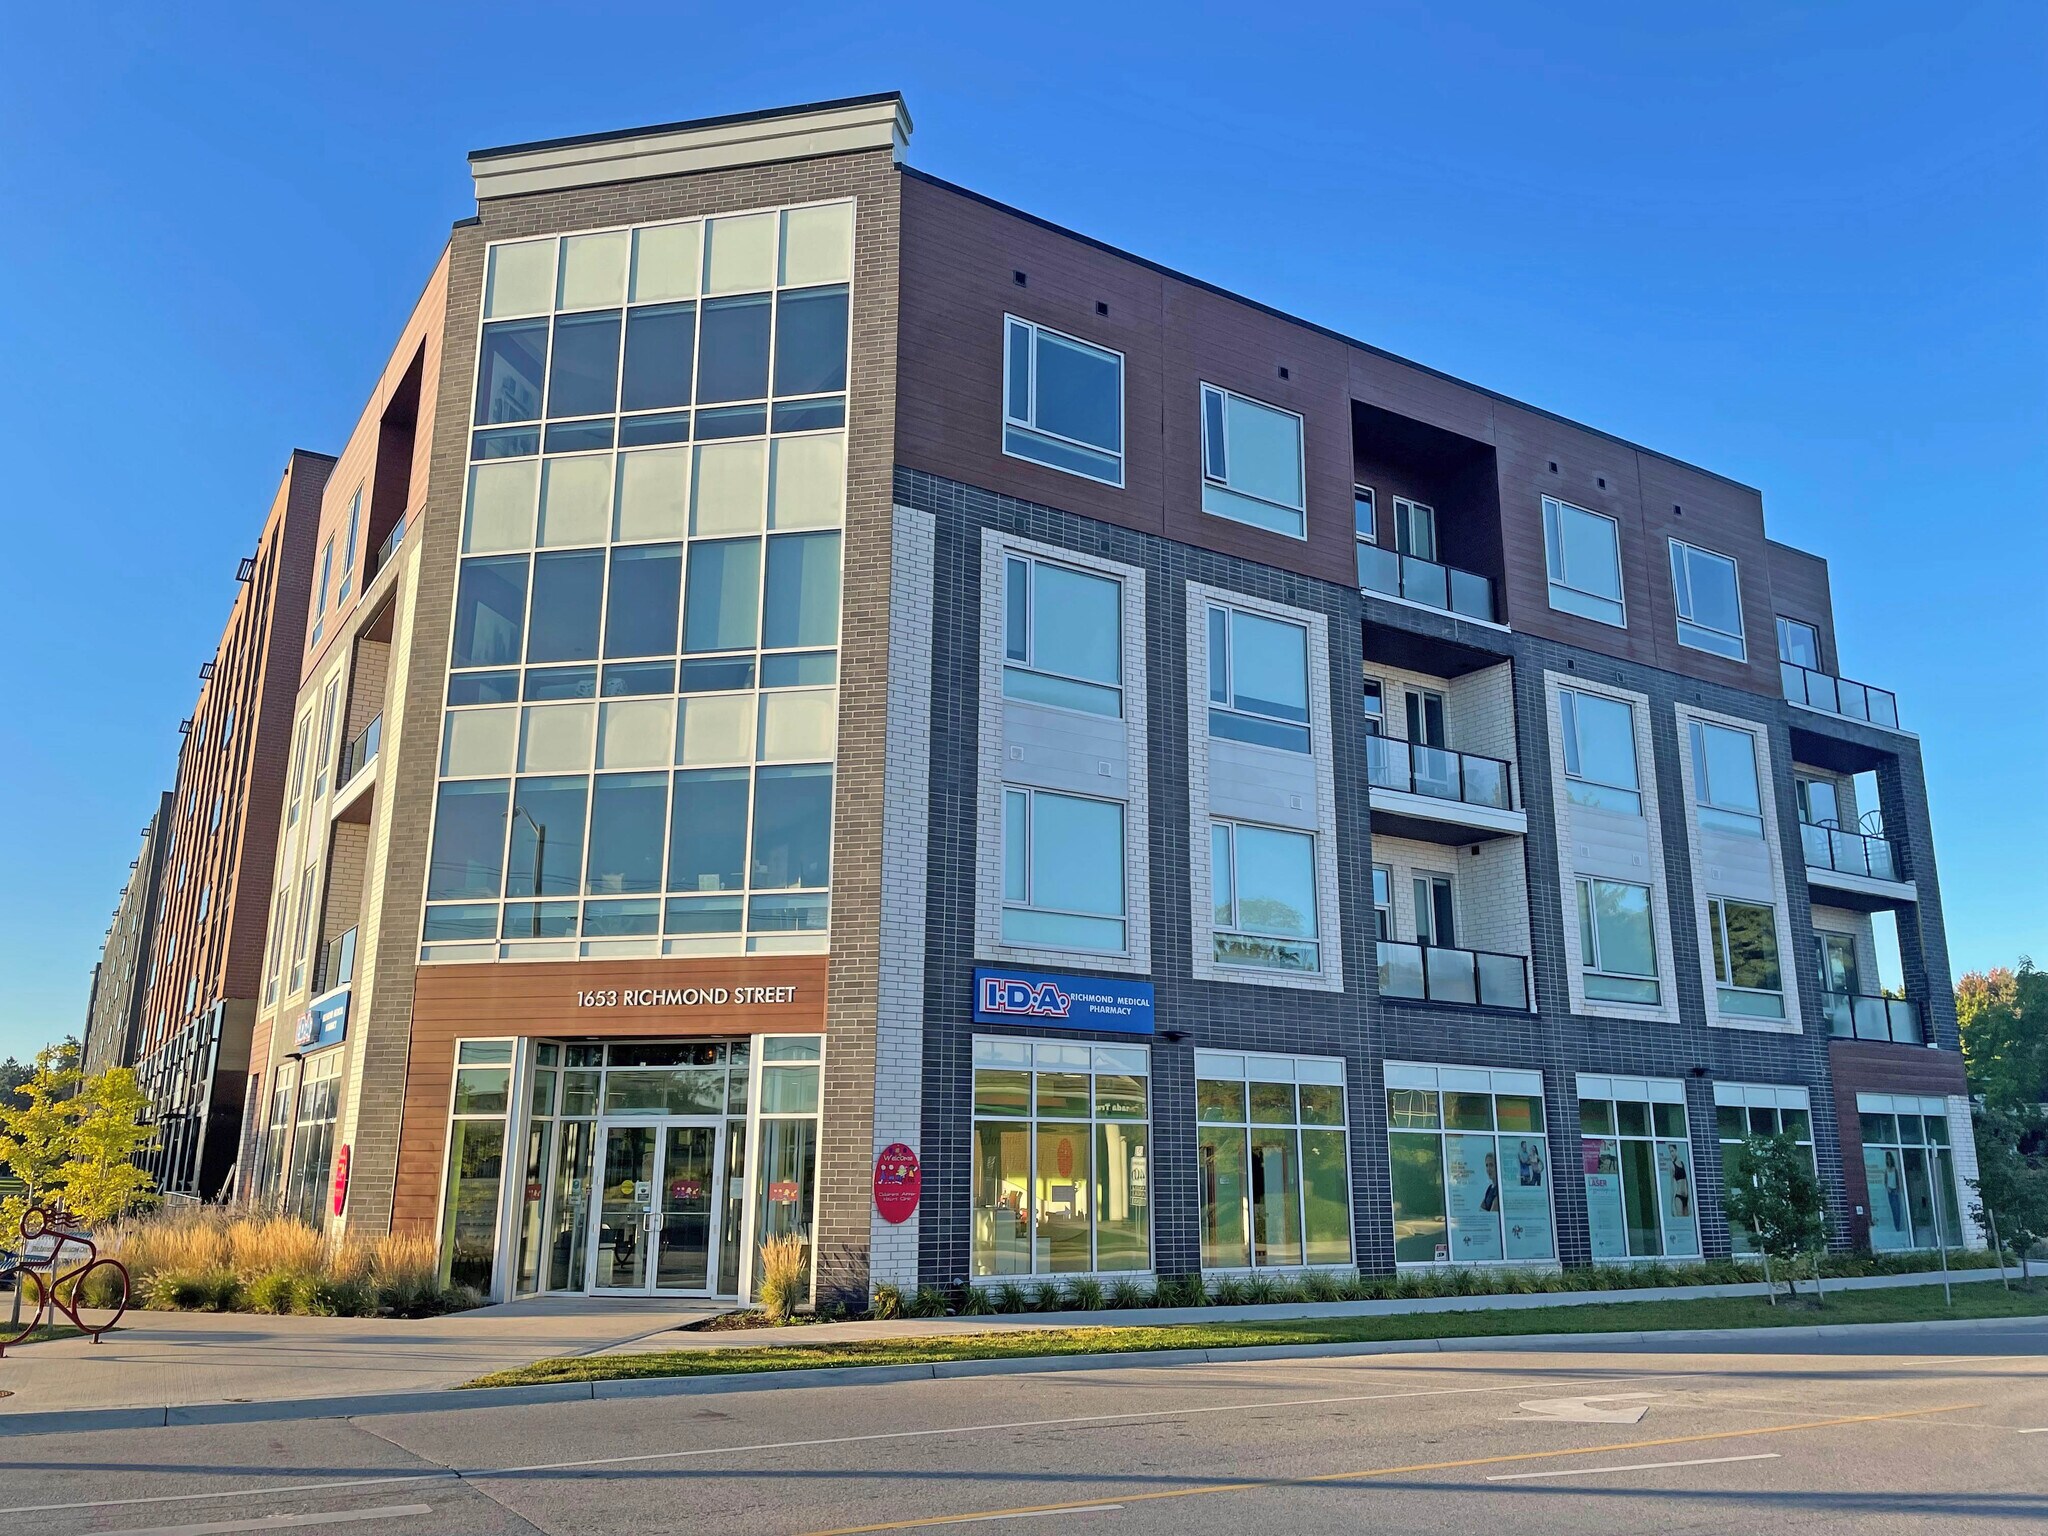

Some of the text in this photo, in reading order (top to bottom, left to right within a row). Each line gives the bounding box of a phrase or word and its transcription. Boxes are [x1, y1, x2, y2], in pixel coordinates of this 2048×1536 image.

[576, 986, 797, 1007] 1653 RICHMOND STREET
[1070, 992, 1150, 1007] RICHMOND MEDICAL
[1089, 1005, 1131, 1015] PHARMACY
[1589, 1179, 1607, 1187] LASER
